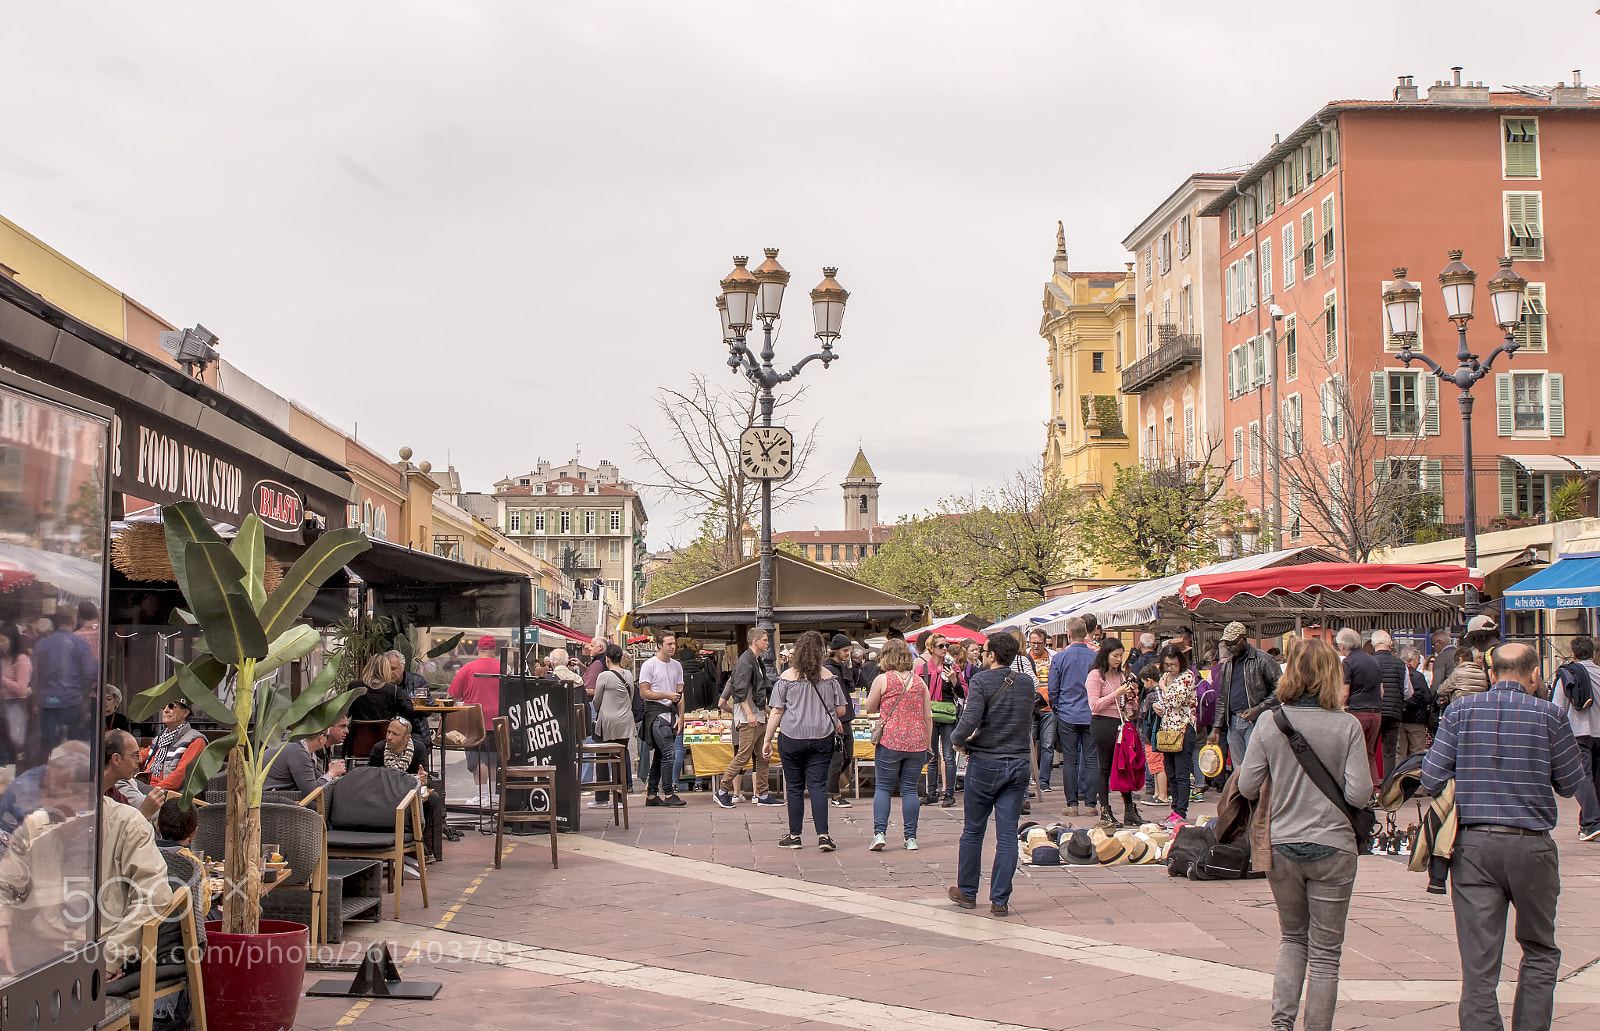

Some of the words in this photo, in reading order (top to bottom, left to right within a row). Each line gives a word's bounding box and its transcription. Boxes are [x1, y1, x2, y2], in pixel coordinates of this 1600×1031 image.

[137, 425, 179, 494] FOOD
[181, 445, 211, 504] NON
[211, 457, 242, 515] STOP
[259, 485, 299, 525] BLAST
[1514, 597, 1521, 607] Au
[1528, 596, 1535, 607] de
[1535, 596, 1546, 607] bois
[1556, 595, 1583, 607] Restaurant
[526, 718, 563, 754] RGER
